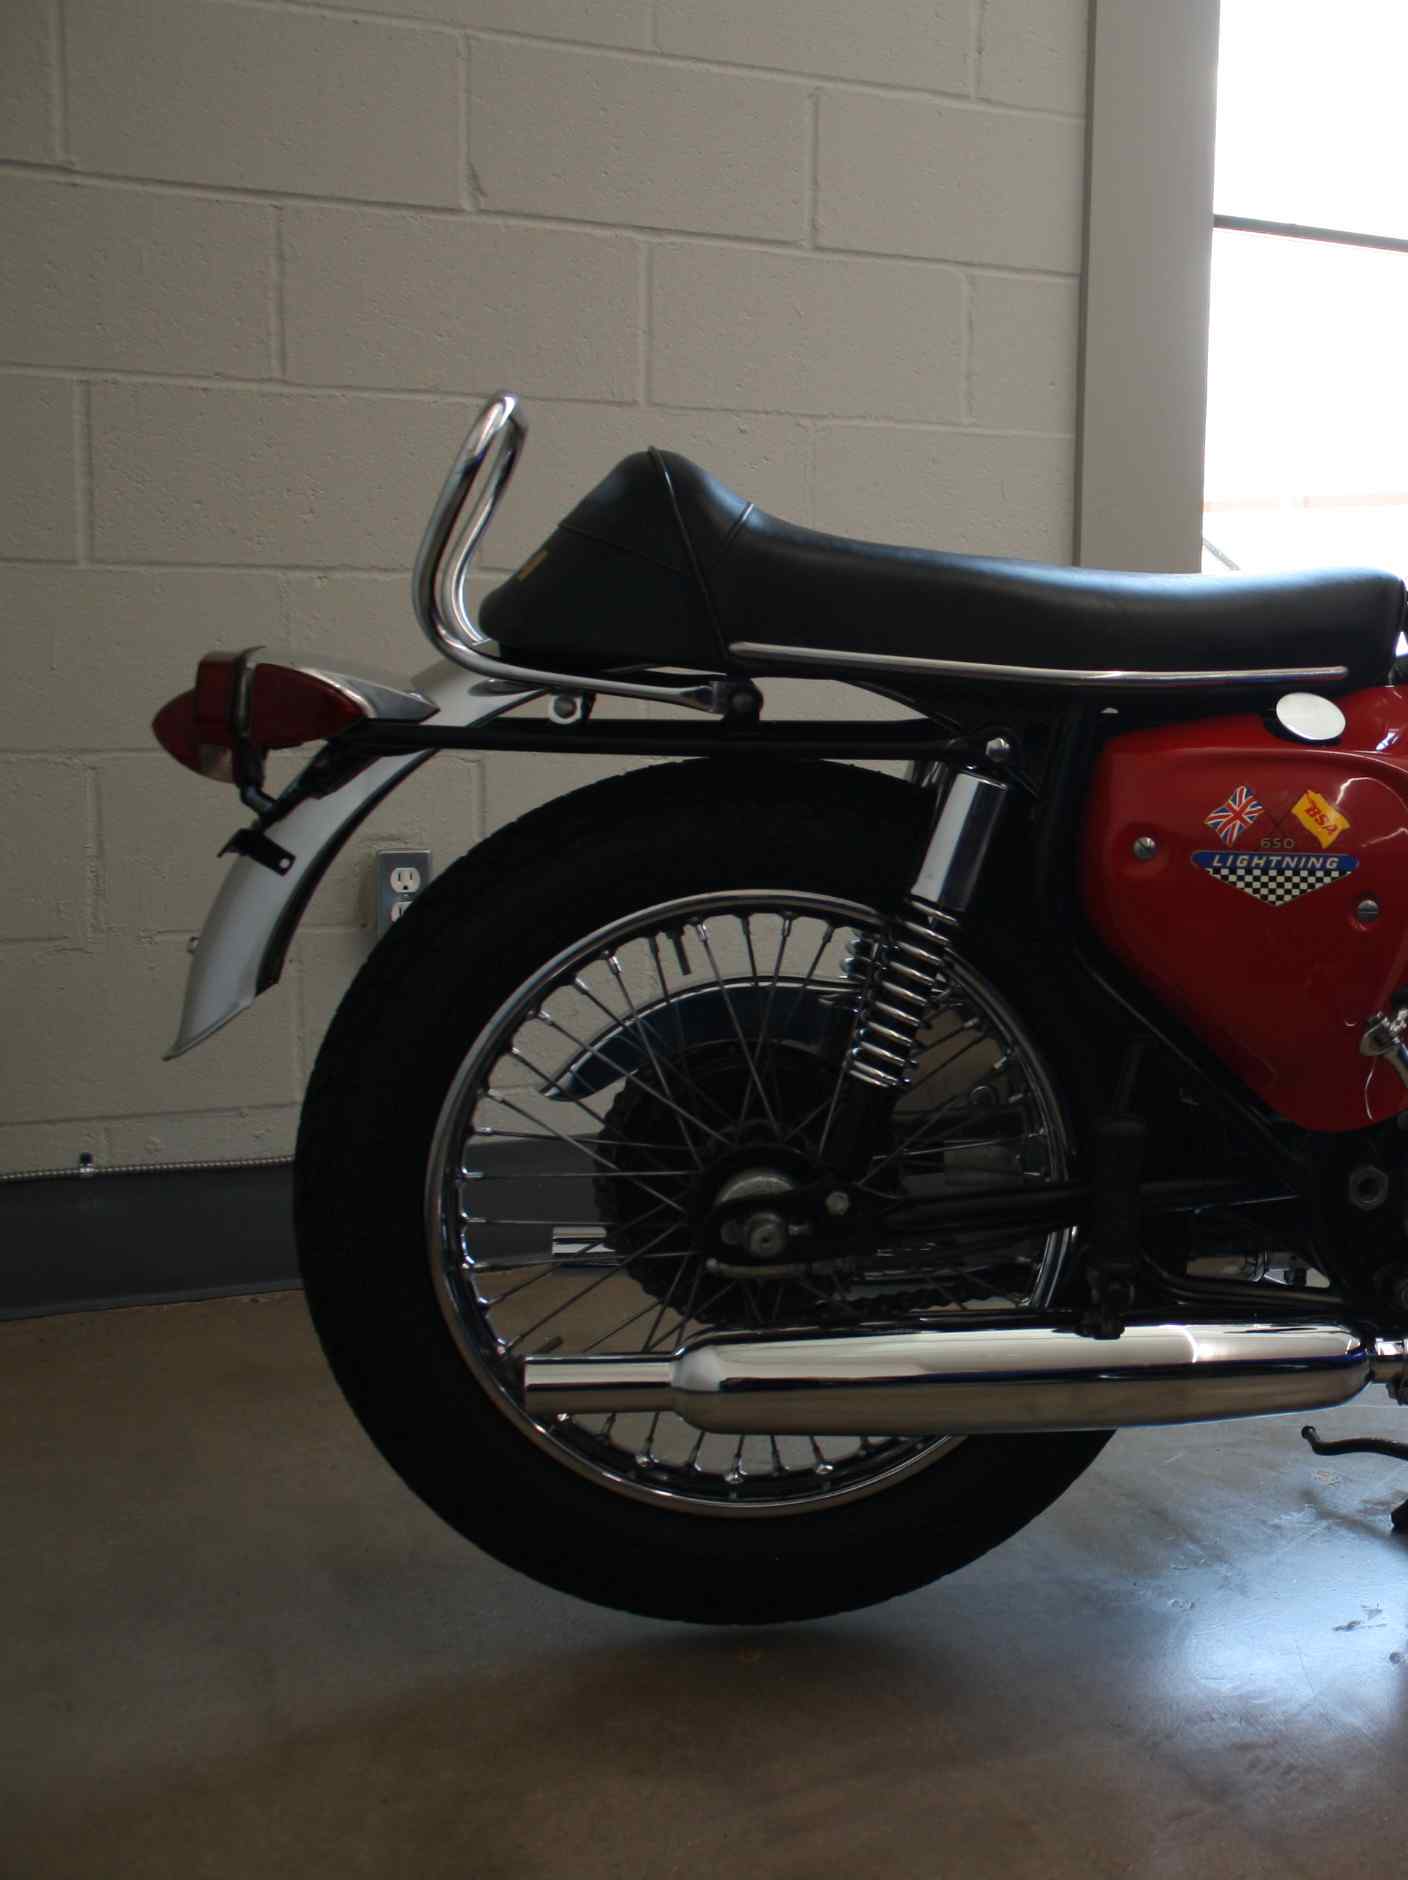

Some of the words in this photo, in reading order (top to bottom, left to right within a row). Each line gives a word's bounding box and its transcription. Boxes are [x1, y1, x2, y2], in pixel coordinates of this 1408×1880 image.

[1304, 799, 1338, 835] BSA
[1260, 837, 1296, 849] 650
[1212, 854, 1340, 870] LIGHTNING
